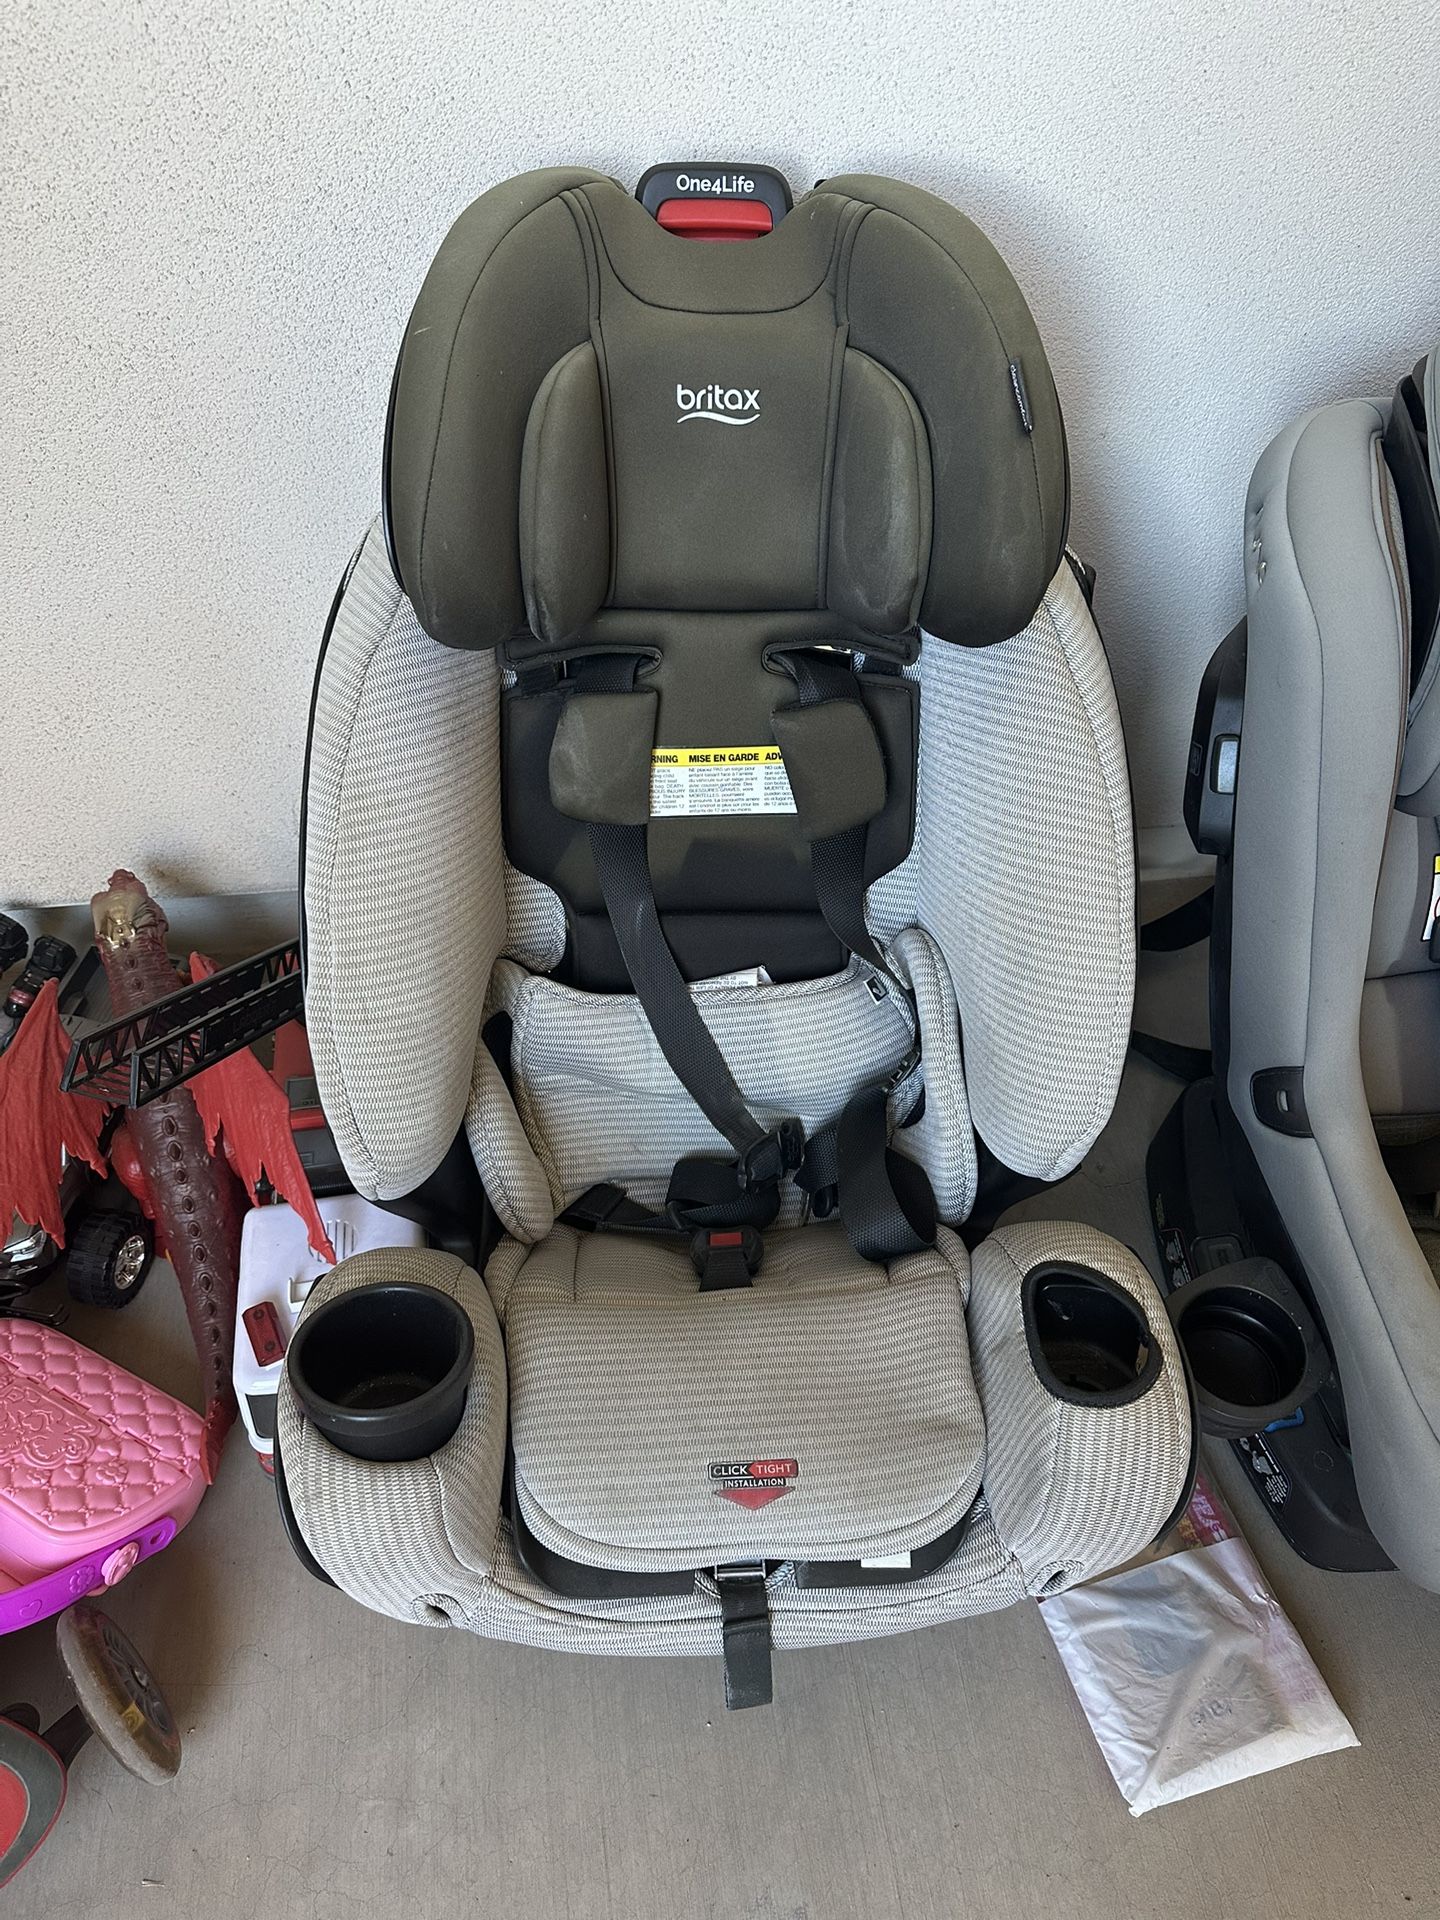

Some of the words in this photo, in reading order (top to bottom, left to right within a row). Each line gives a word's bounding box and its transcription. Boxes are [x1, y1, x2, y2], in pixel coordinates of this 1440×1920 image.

[676, 174, 755, 195] One4Life
[676, 384, 761, 410] britax
[651, 755, 678, 763] RNING
[729, 753, 759, 761] GARDE
[713, 1464, 748, 1476] CLICK
[755, 1463, 792, 1474] TIGHT
[724, 1478, 784, 1488] INSTALLATION
